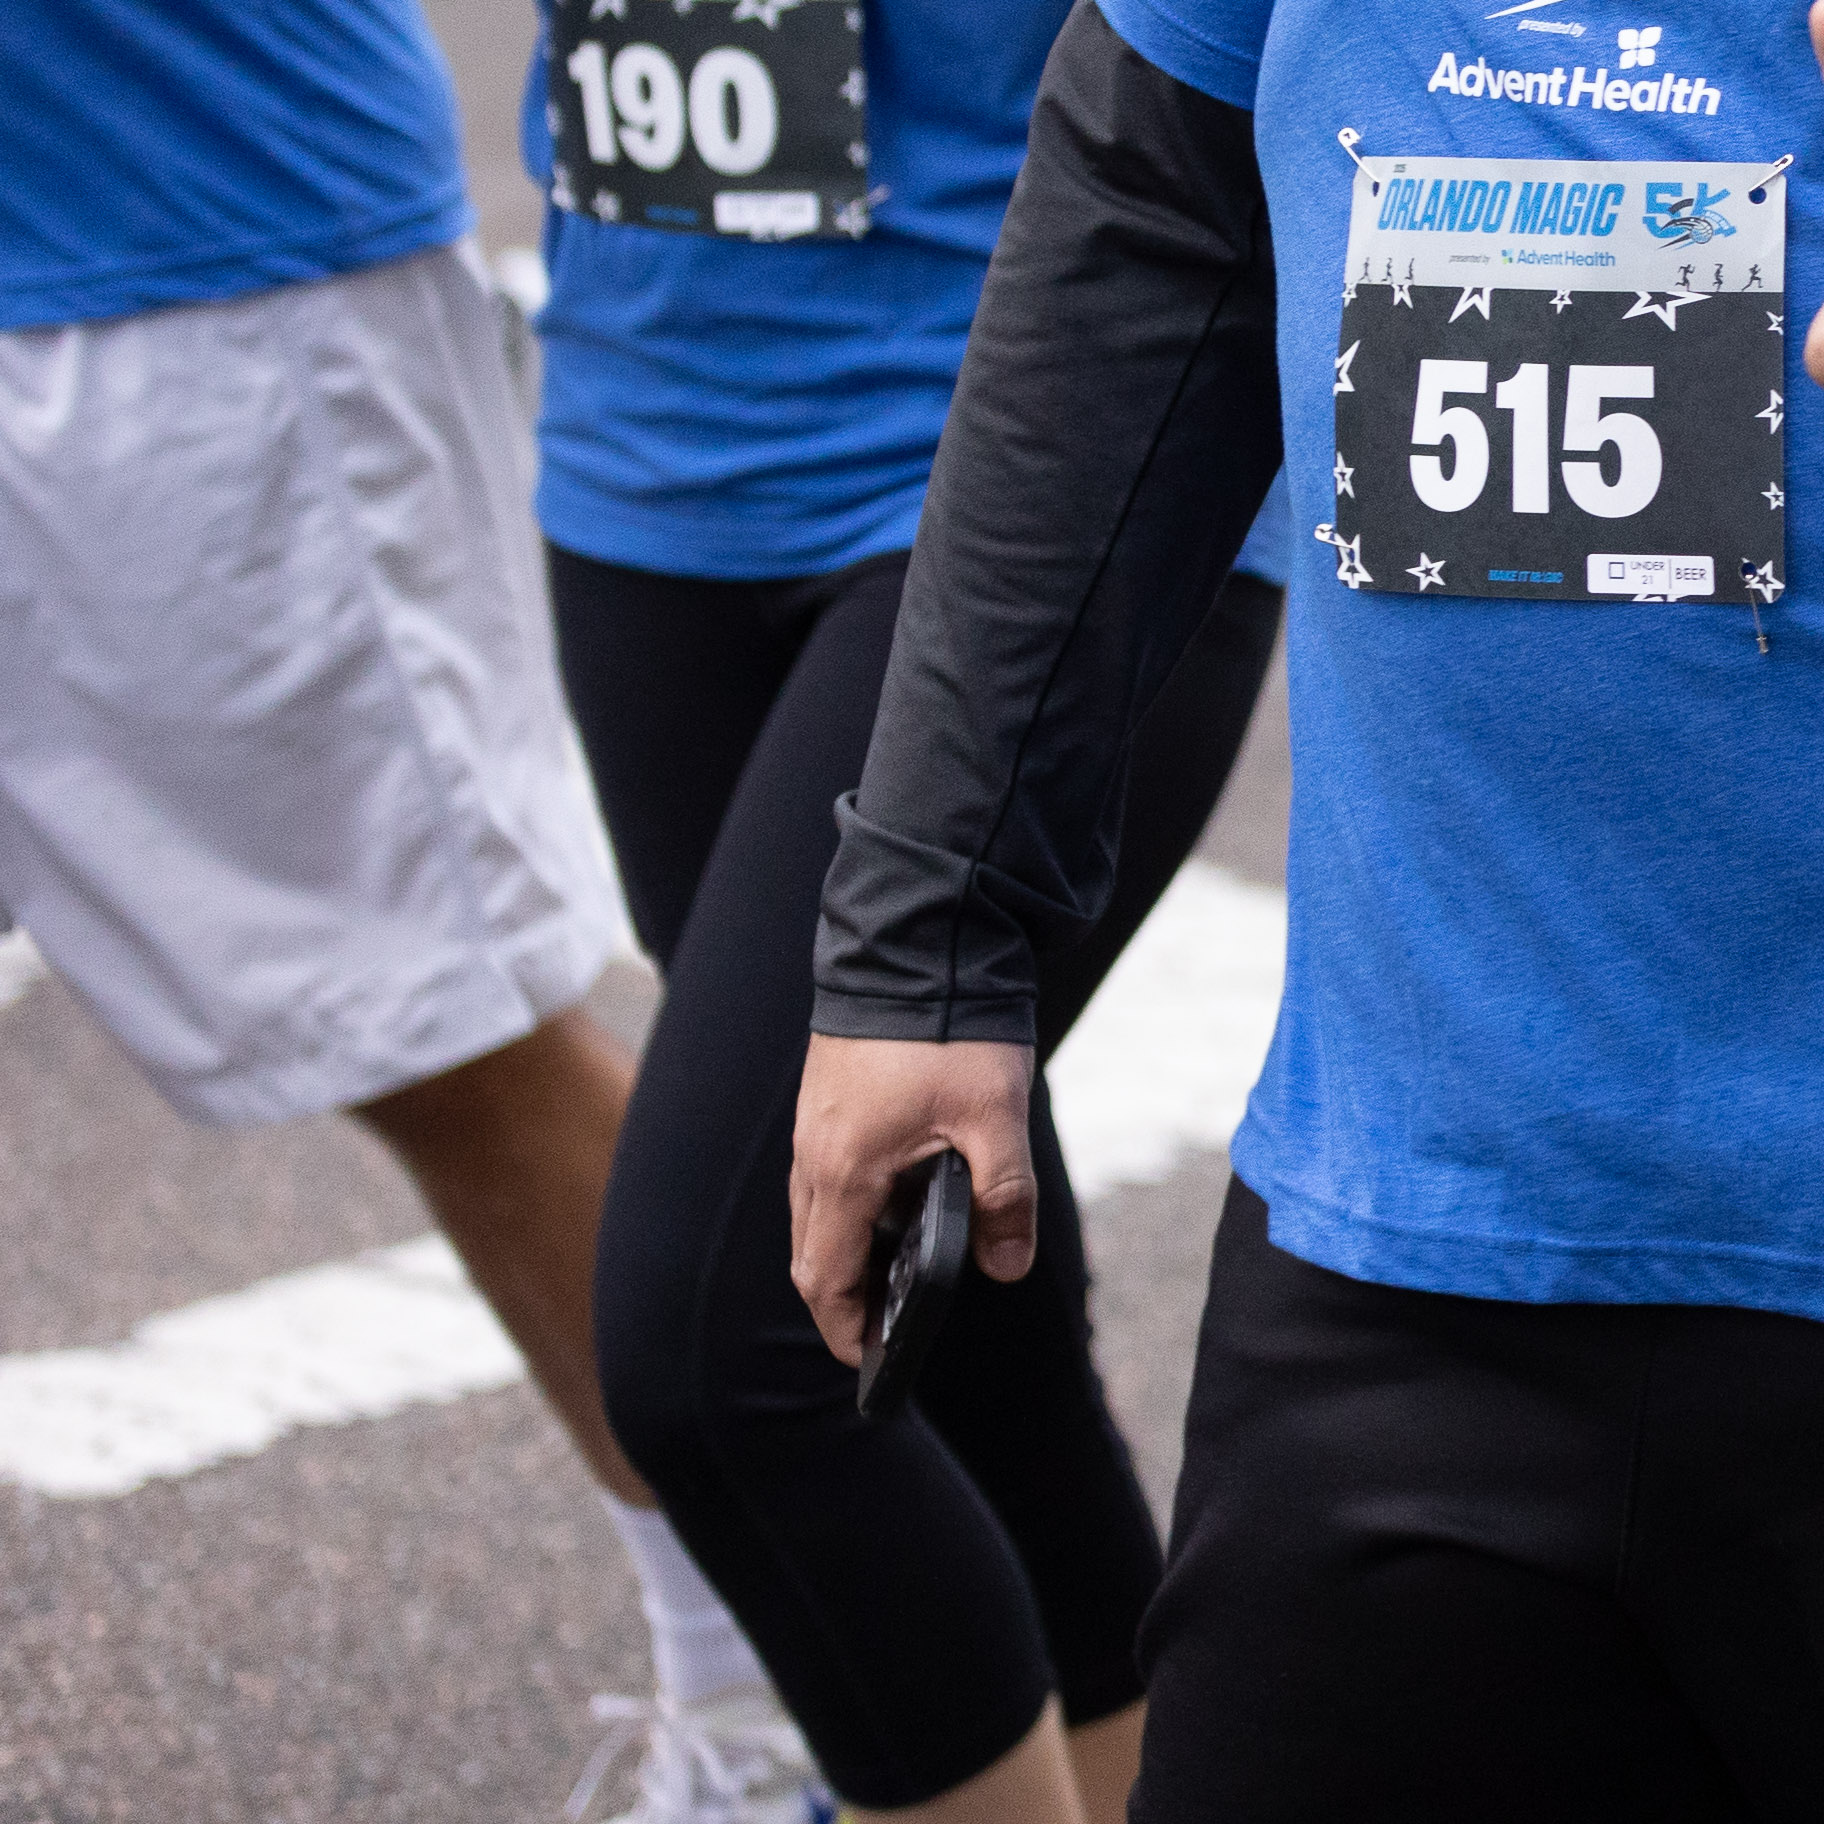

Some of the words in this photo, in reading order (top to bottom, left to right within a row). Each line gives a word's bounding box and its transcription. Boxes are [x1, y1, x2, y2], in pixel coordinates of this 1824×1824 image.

[567, 39, 780, 176] 190
[1427, 51, 1722, 116] AdventHealth
[1377, 178, 1512, 234] ORLANDO
[1509, 181, 1626, 237] MAGIC
[1642, 182, 1736, 238] 5K
[1517, 249, 1616, 267] AdventHealth
[1408, 358, 1663, 519] 515
[1675, 567, 1707, 581] BEER
